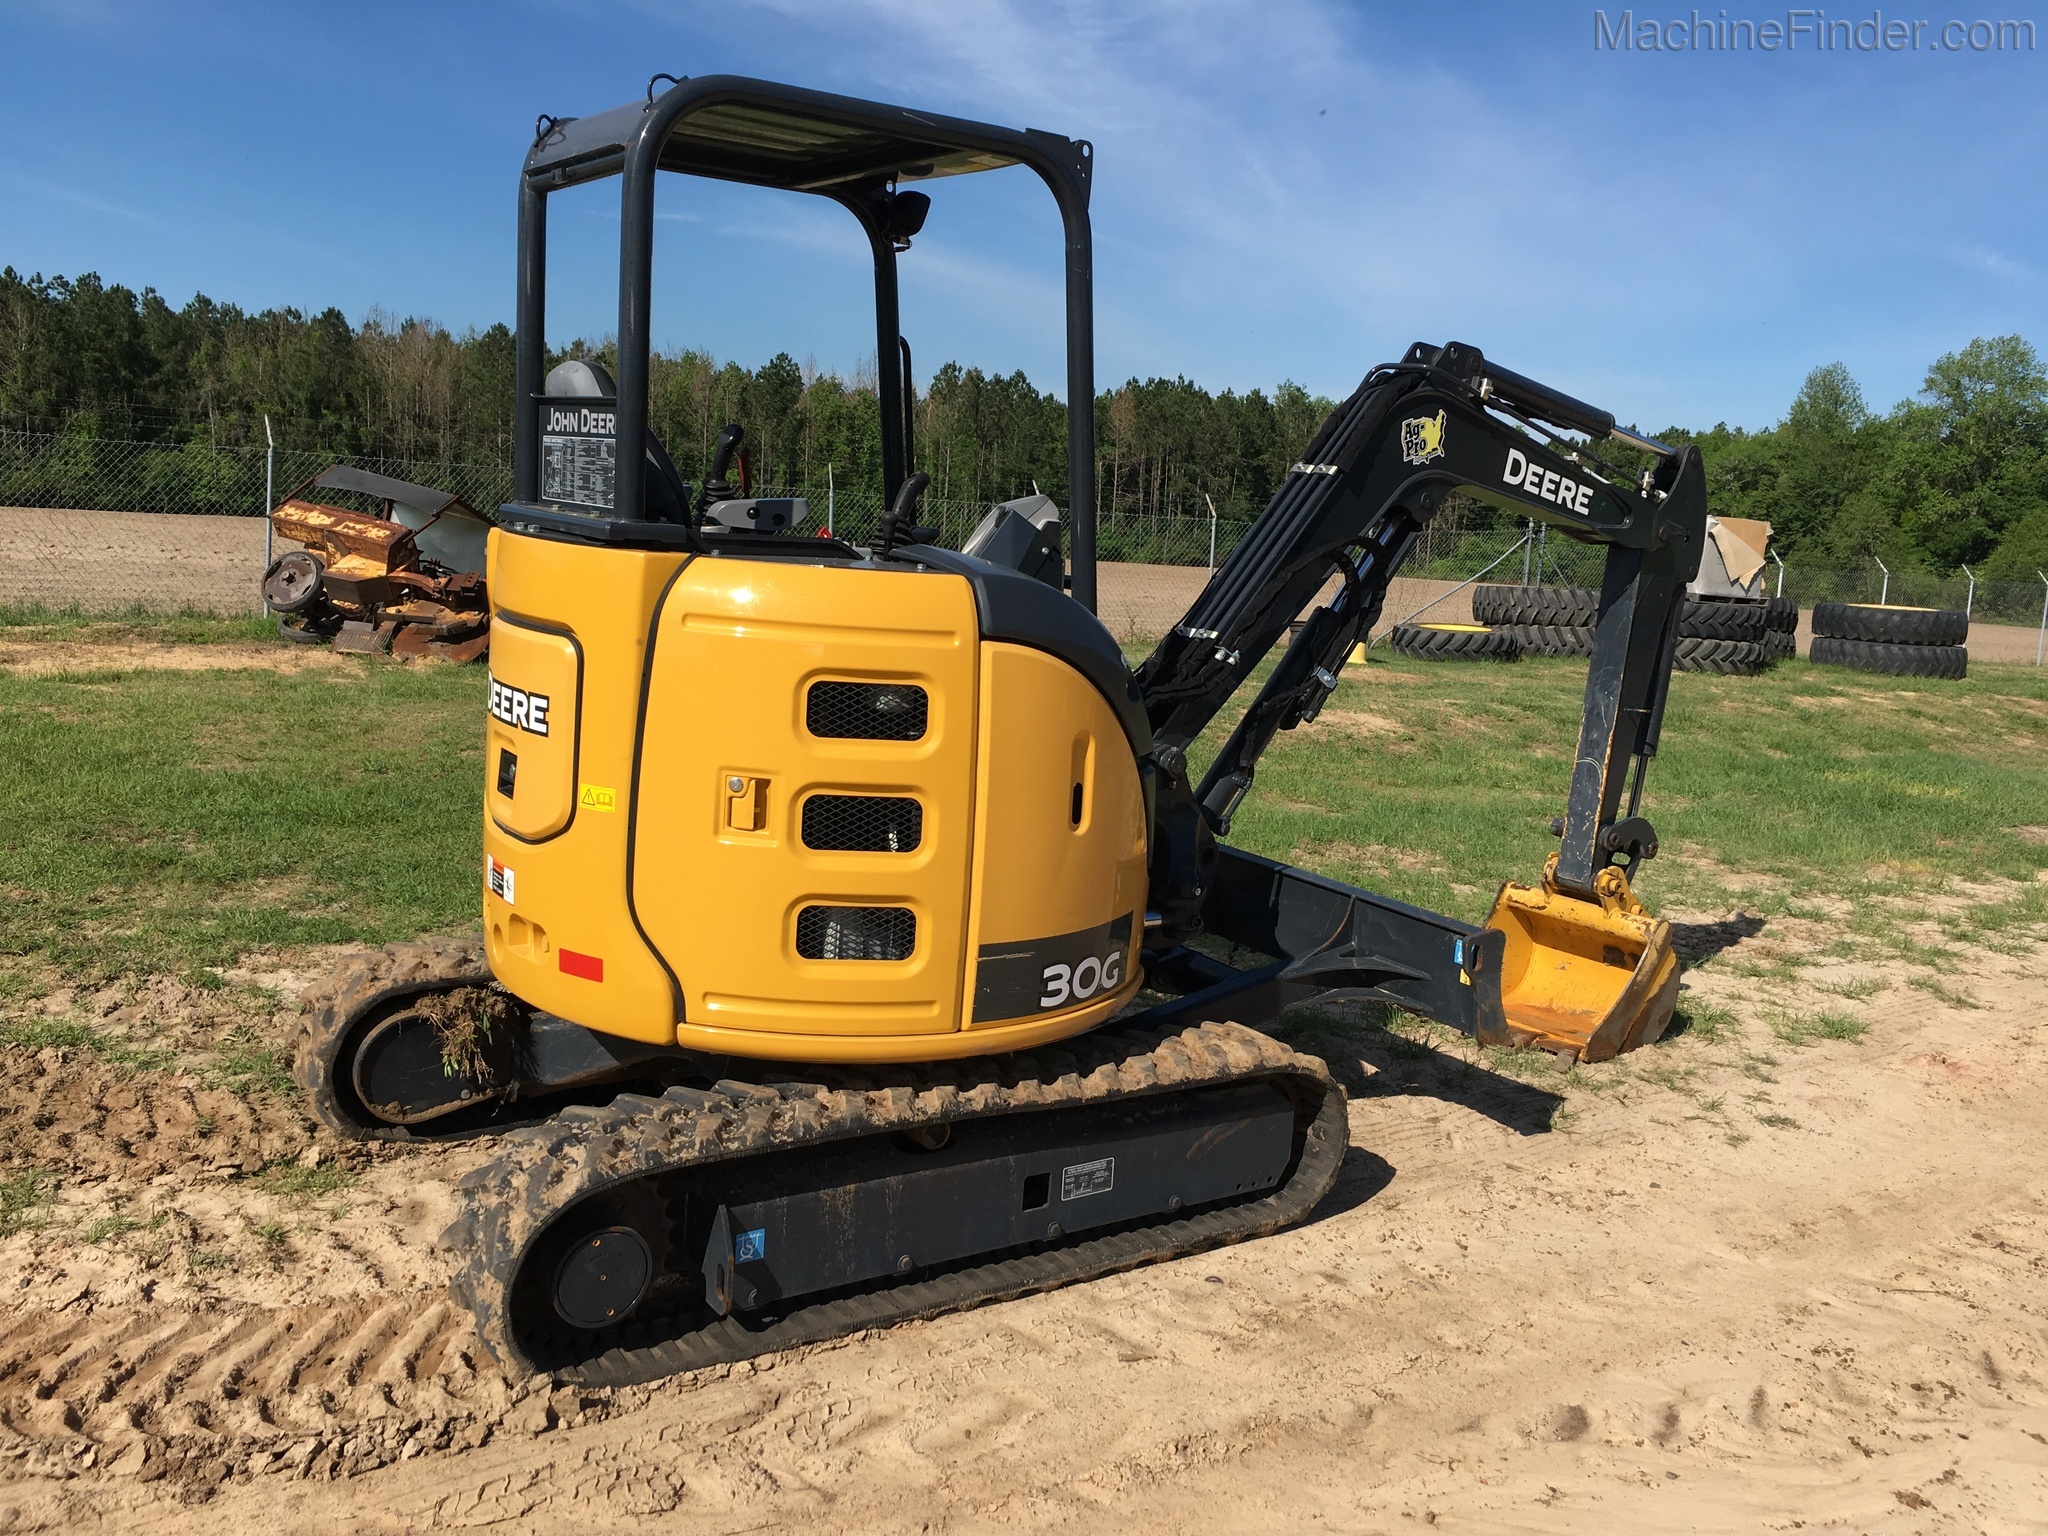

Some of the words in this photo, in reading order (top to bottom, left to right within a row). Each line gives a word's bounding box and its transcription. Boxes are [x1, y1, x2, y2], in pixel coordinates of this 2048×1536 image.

[546, 407, 579, 433] JOHN
[580, 408, 617, 434] DEER
[1404, 421, 1425, 441] Ag-
[1405, 438, 1427, 458] Pro
[1502, 447, 1594, 516] DEERE
[1040, 951, 1121, 1008] 30G
